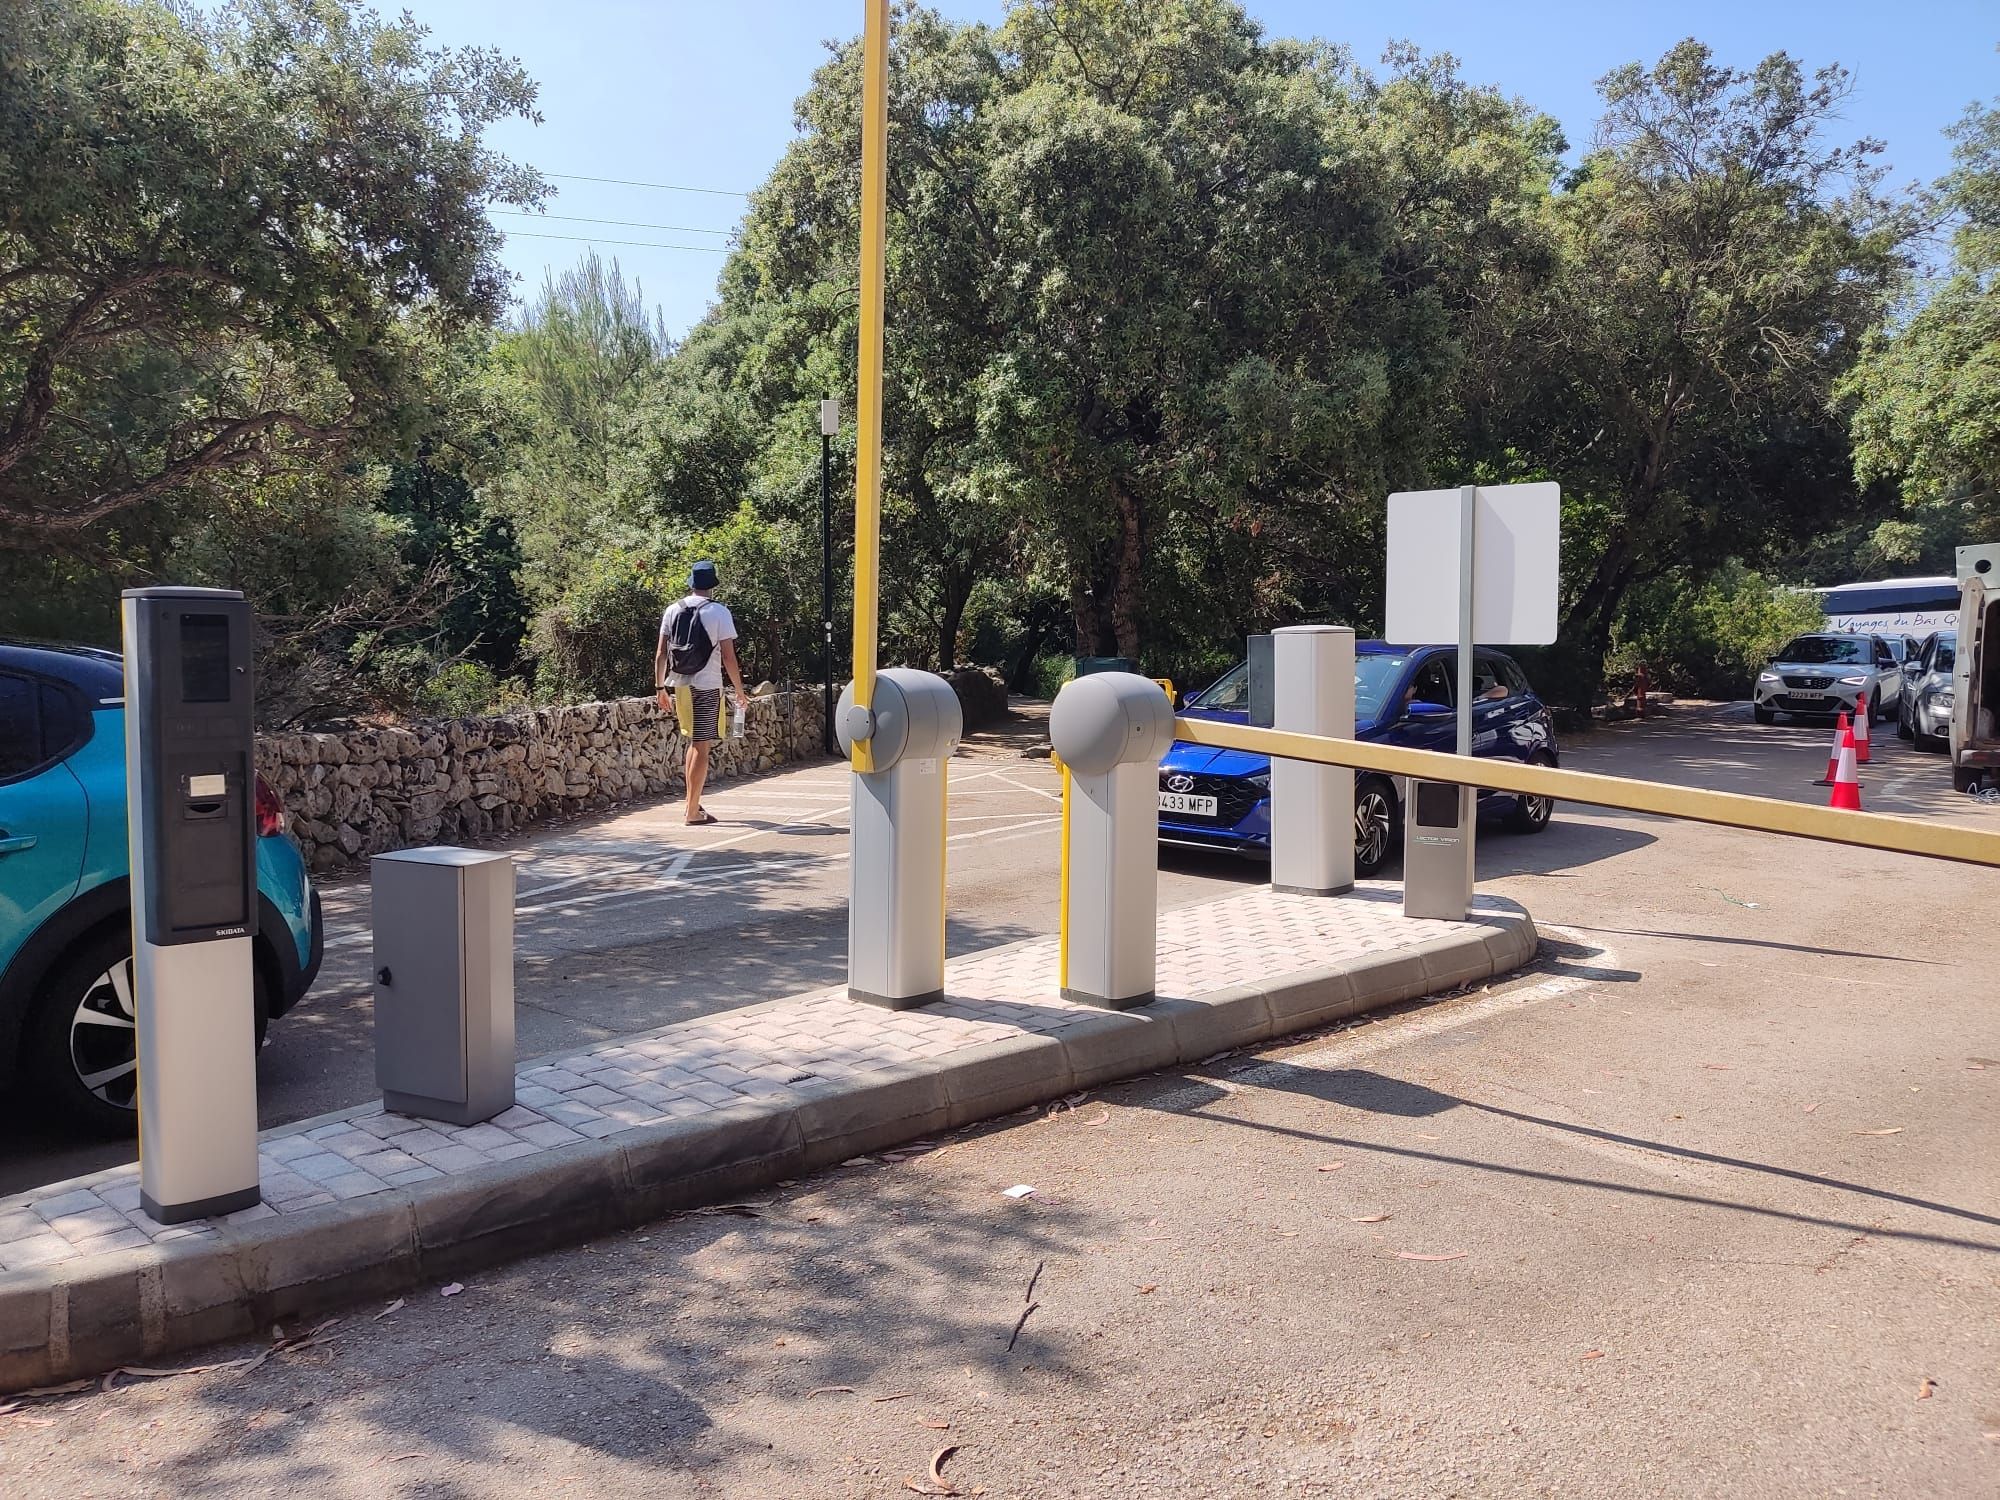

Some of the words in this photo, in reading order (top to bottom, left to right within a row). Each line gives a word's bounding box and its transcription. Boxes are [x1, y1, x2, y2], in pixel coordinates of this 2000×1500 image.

[1838, 616, 1888, 633] Voyages
[1894, 612, 1909, 626] du
[1913, 612, 1937, 627] Bas
[1188, 797, 1213, 813] MFP
[215, 927, 246, 937] SKIDATA
